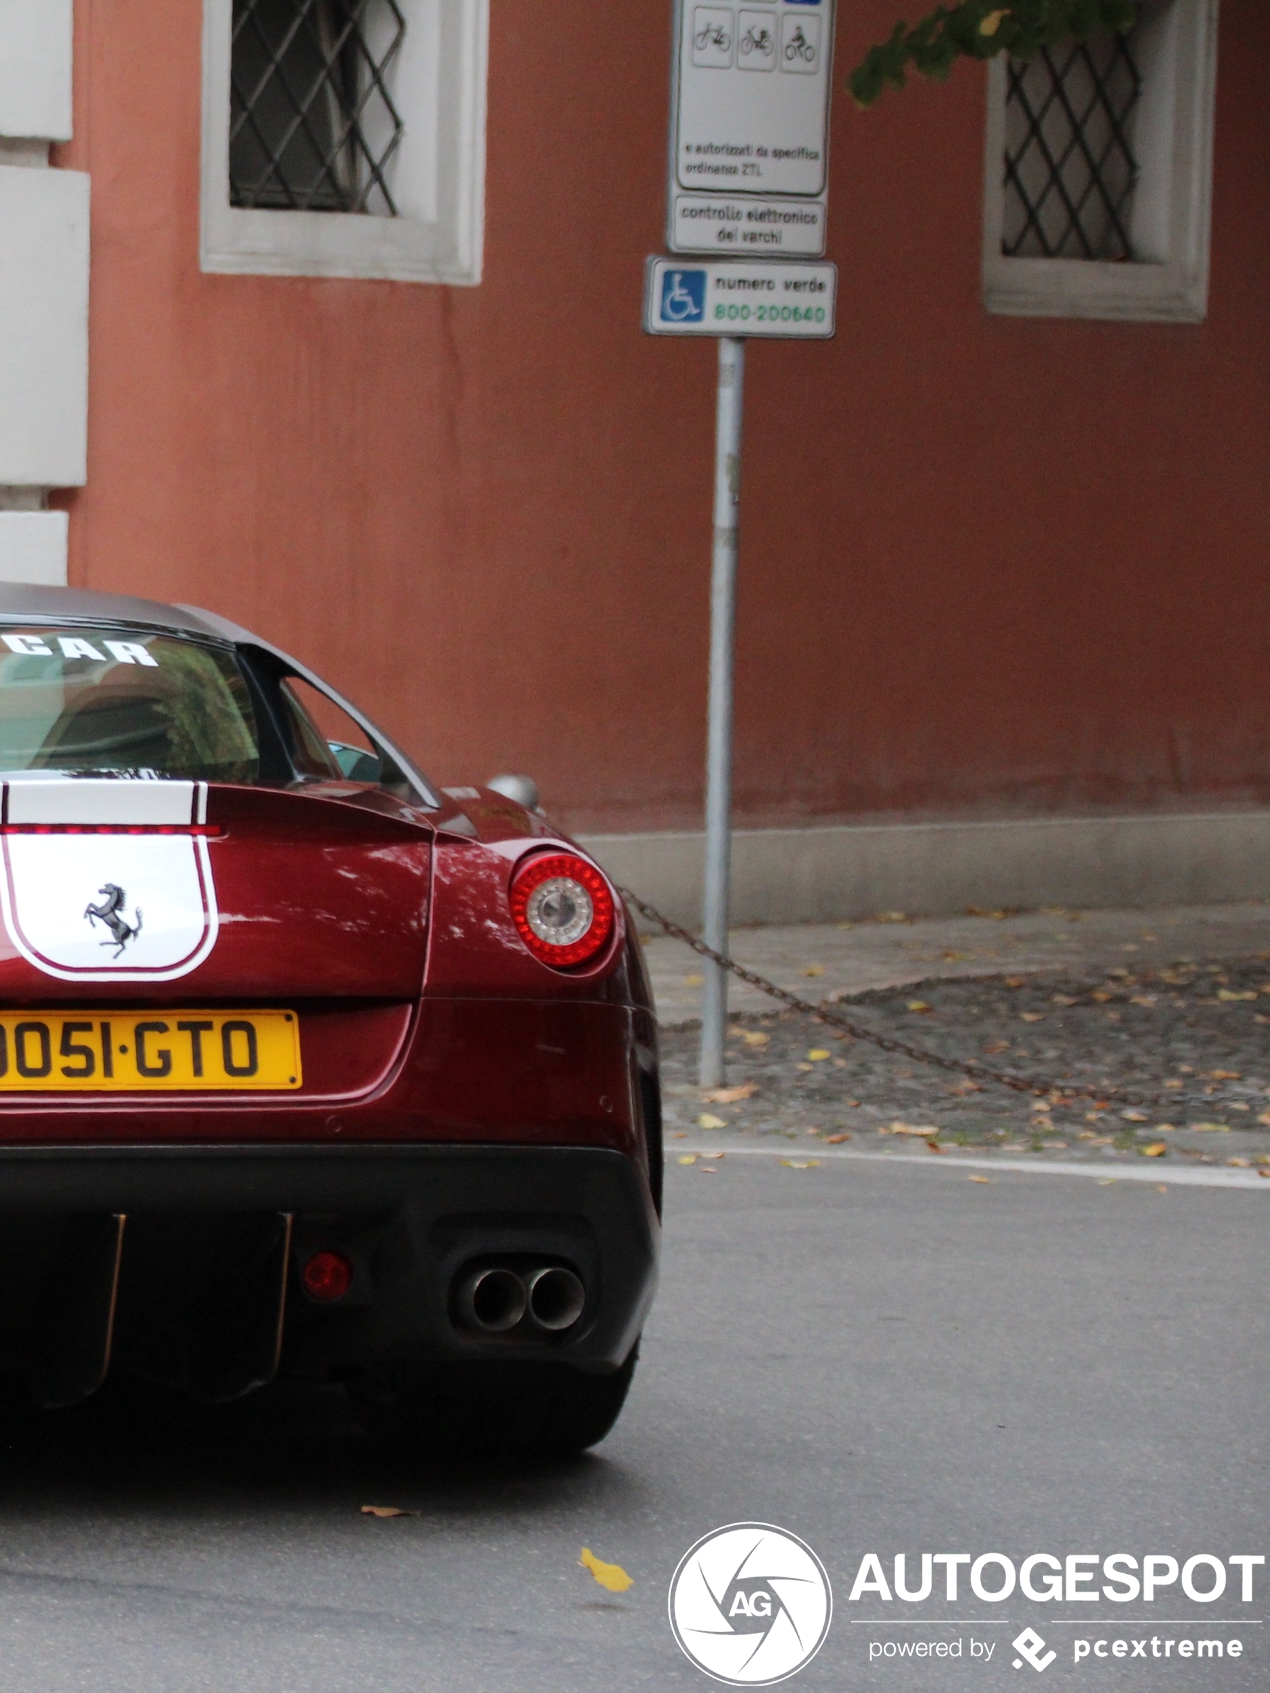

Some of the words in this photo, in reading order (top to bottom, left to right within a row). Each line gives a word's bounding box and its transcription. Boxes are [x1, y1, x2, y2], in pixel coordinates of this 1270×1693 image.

[695, 143, 755, 157] autorizzati
[757, 146, 770, 158] da
[772, 147, 820, 161] specifica
[686, 162, 739, 175] ordinanza
[682, 205, 743, 221] controllo
[747, 208, 819, 225] elettronico
[717, 226, 739, 243] dei
[742, 228, 783, 244] varchi
[715, 277, 776, 291] numero
[783, 276, 827, 293] verde
[714, 303, 826, 324] 800-200640
[1, 634, 160, 668] CAR
